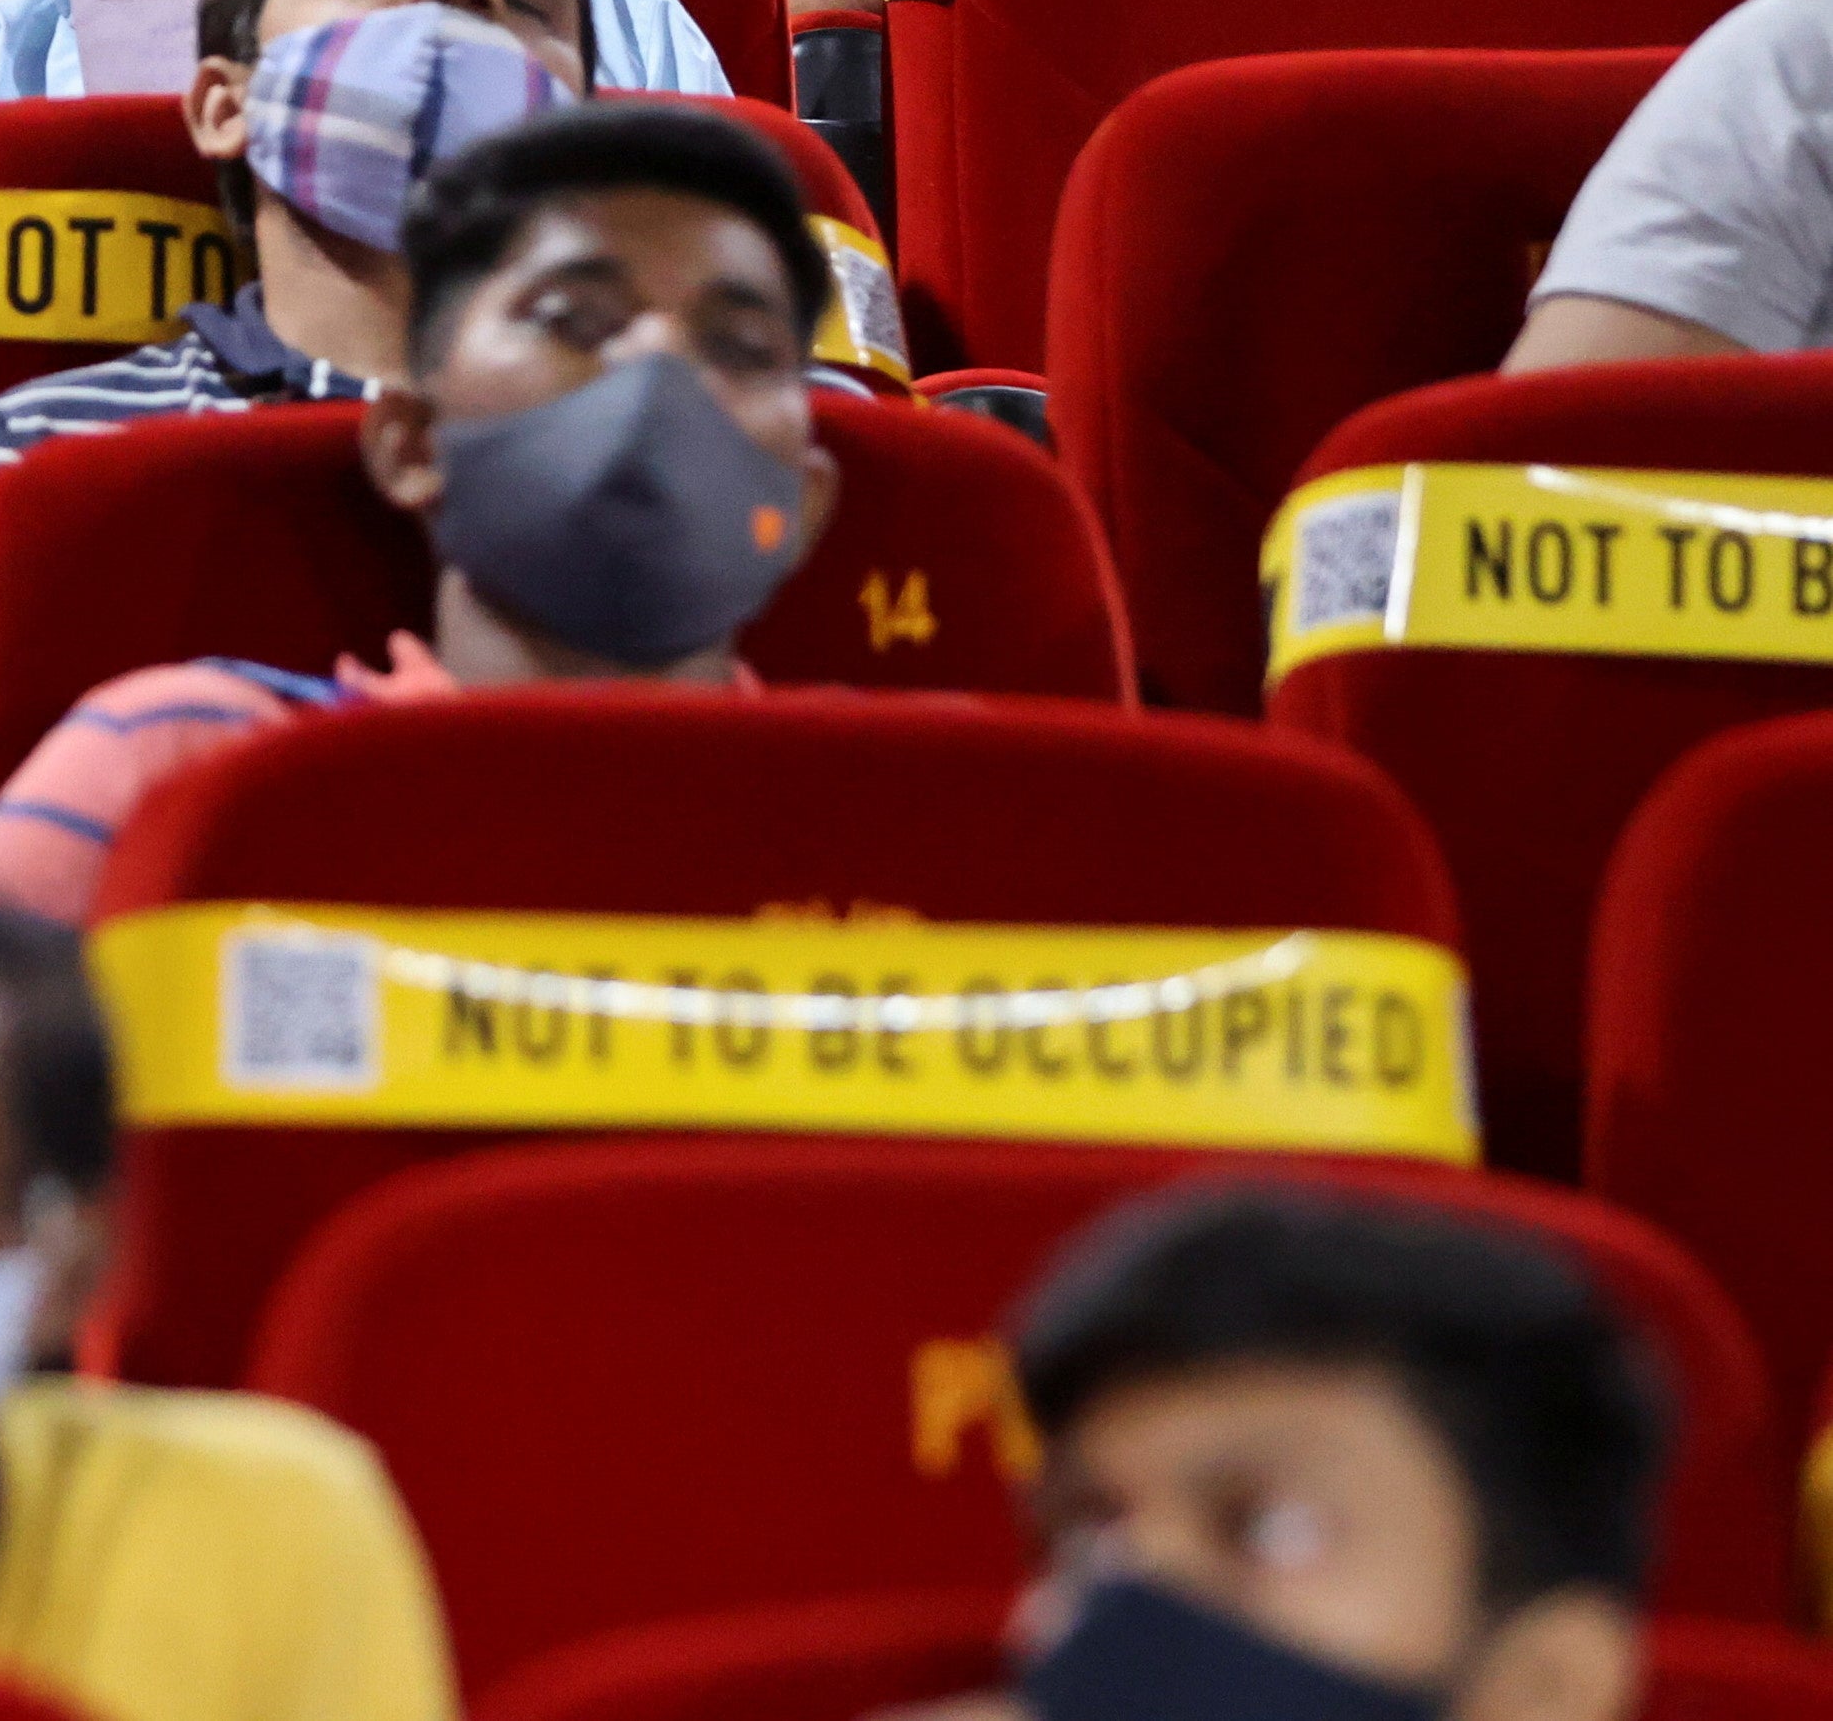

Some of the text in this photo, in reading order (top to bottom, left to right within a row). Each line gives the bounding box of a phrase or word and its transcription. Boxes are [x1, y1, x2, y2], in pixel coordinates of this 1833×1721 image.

[137, 220, 235, 319] TO
[859, 571, 935, 652] 14
[1466, 519, 1833, 615] NOT TO B
[959, 979, 1425, 1087] OCCUPIED
